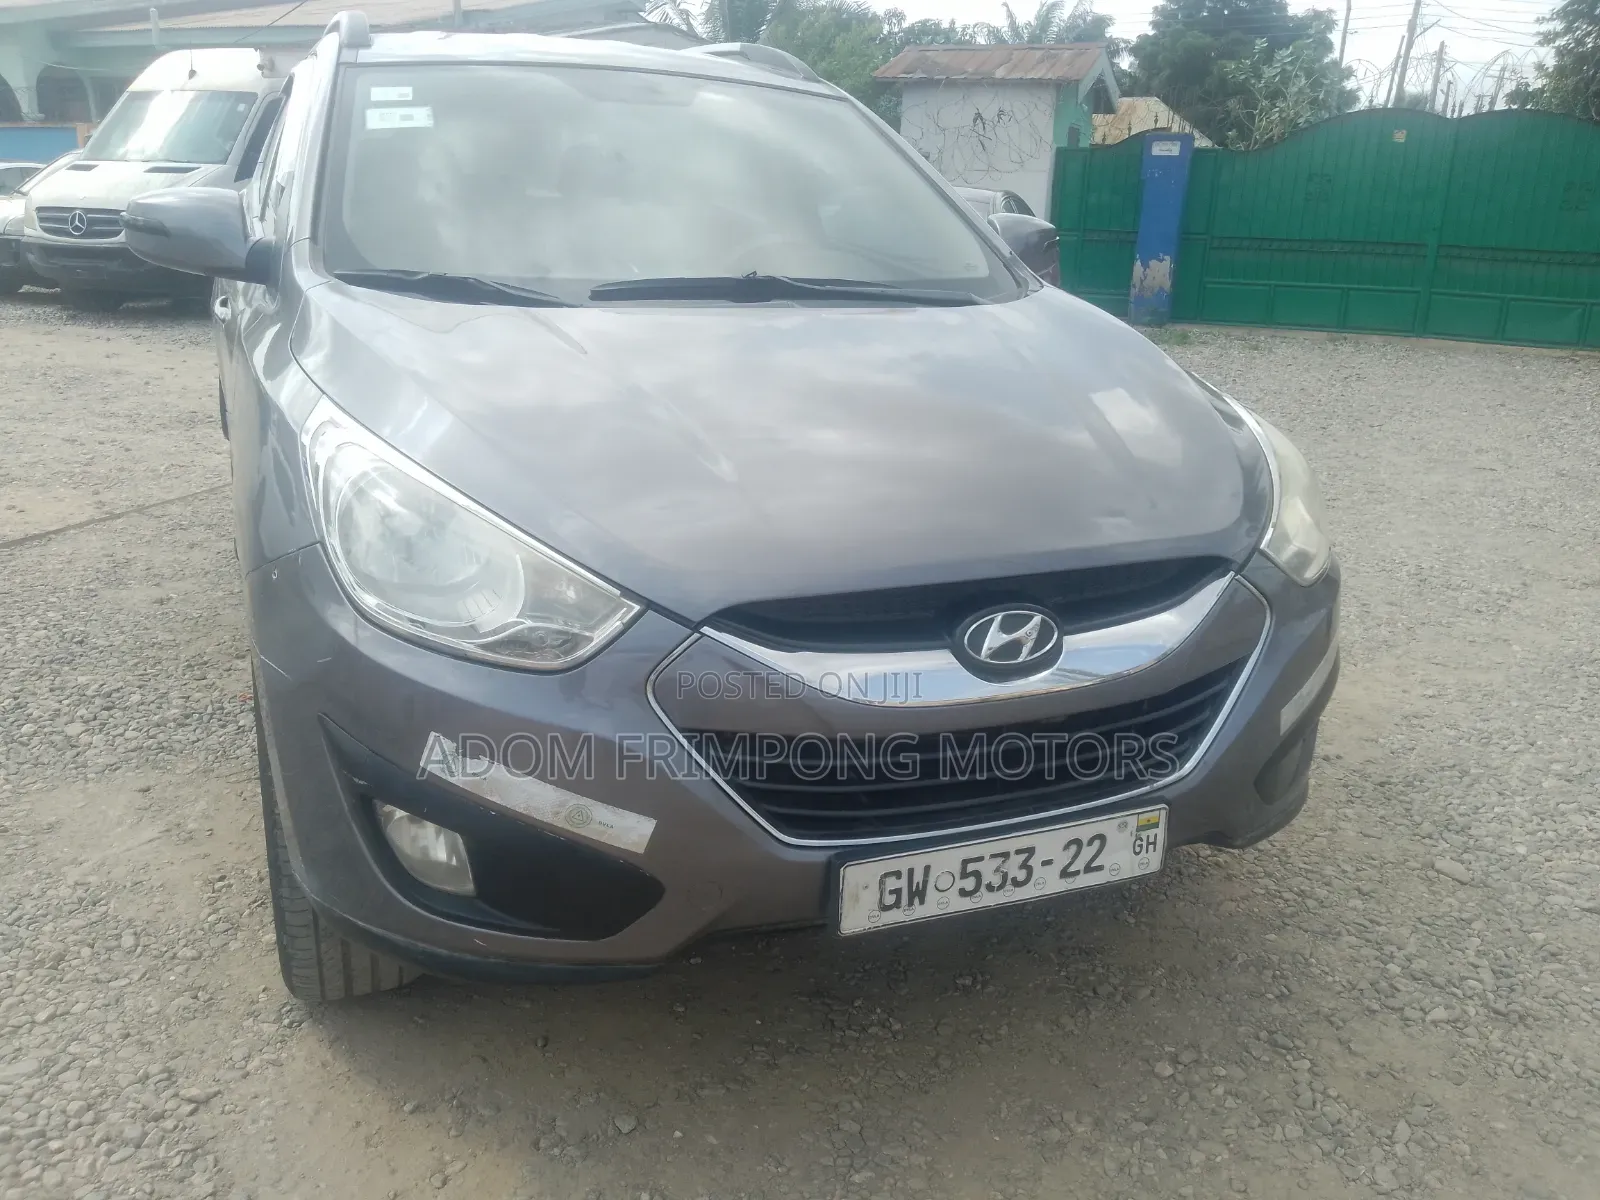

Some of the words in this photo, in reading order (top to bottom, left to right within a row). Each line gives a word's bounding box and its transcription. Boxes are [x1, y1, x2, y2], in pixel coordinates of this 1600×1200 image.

[1132, 833, 1158, 856] GH
[877, 865, 931, 912] GW
[958, 833, 1107, 898] 533-22
